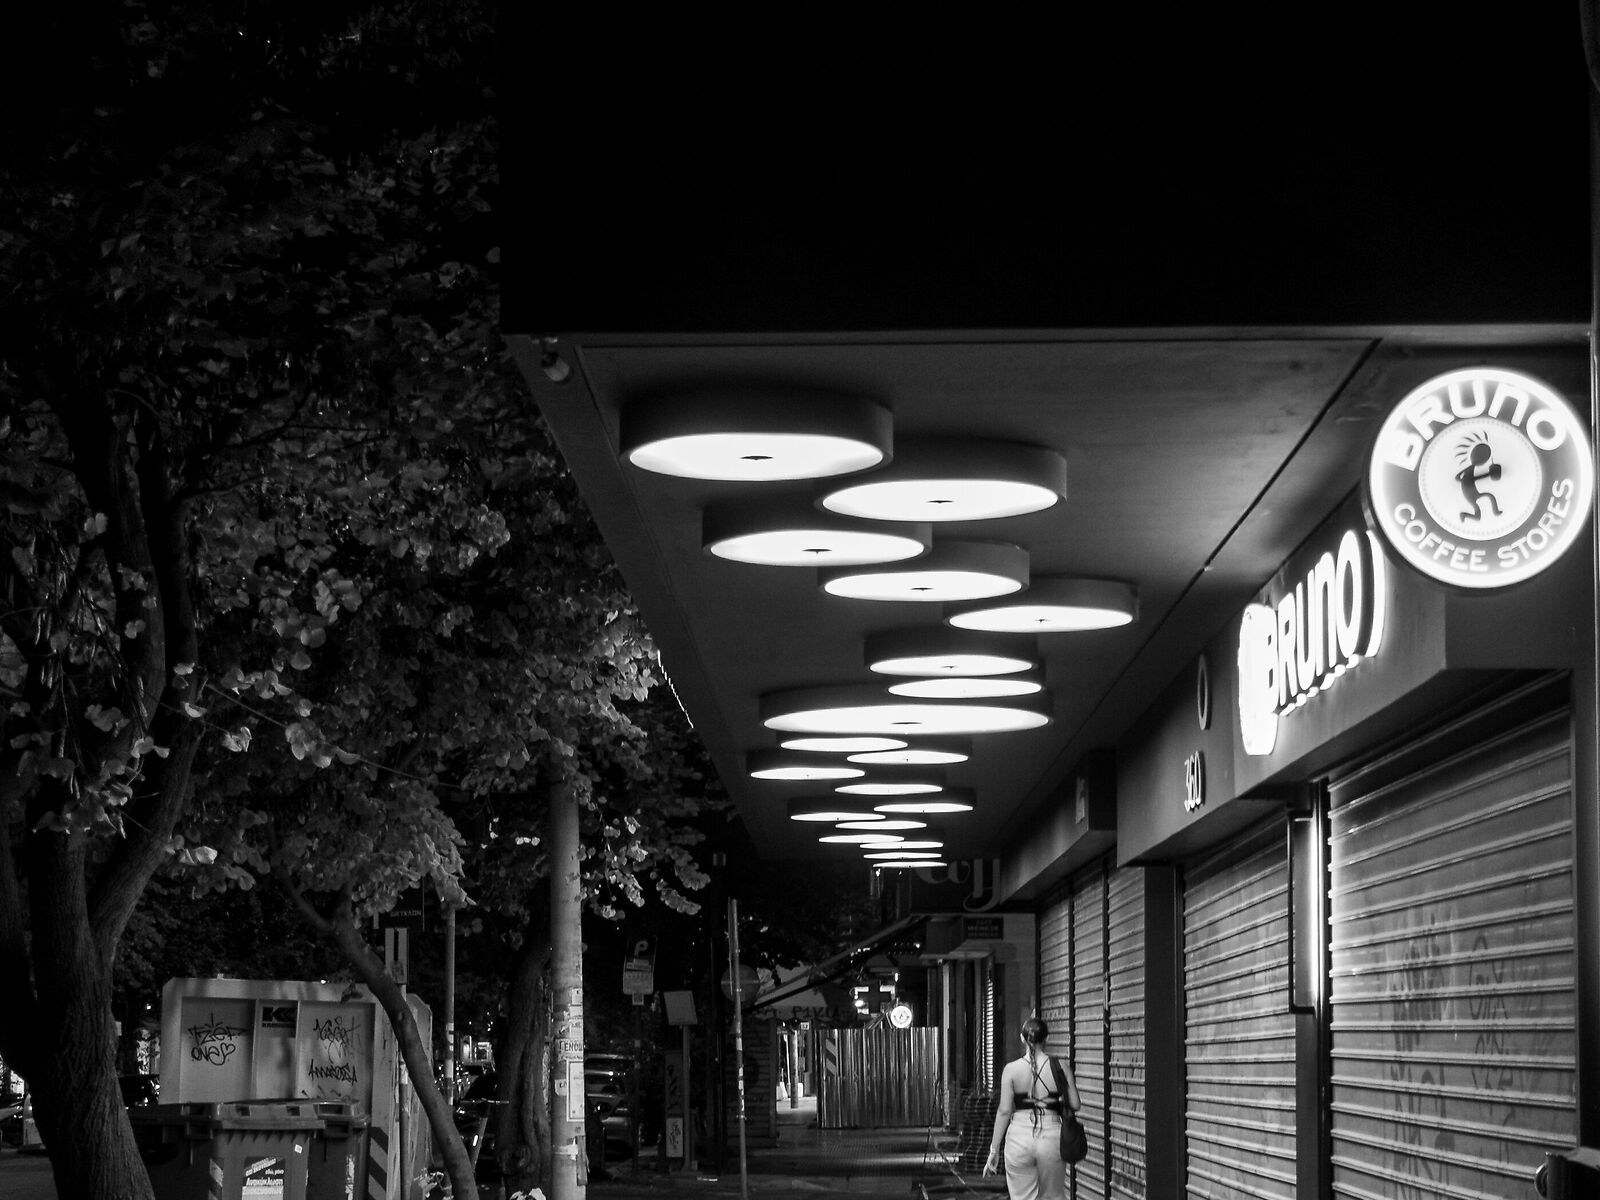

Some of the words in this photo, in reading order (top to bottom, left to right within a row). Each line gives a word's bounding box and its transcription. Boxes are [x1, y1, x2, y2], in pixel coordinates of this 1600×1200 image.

[1383, 379, 1568, 472] BRUNO
[1394, 503, 1488, 572] COFFEE
[1496, 478, 1575, 569] STORES
